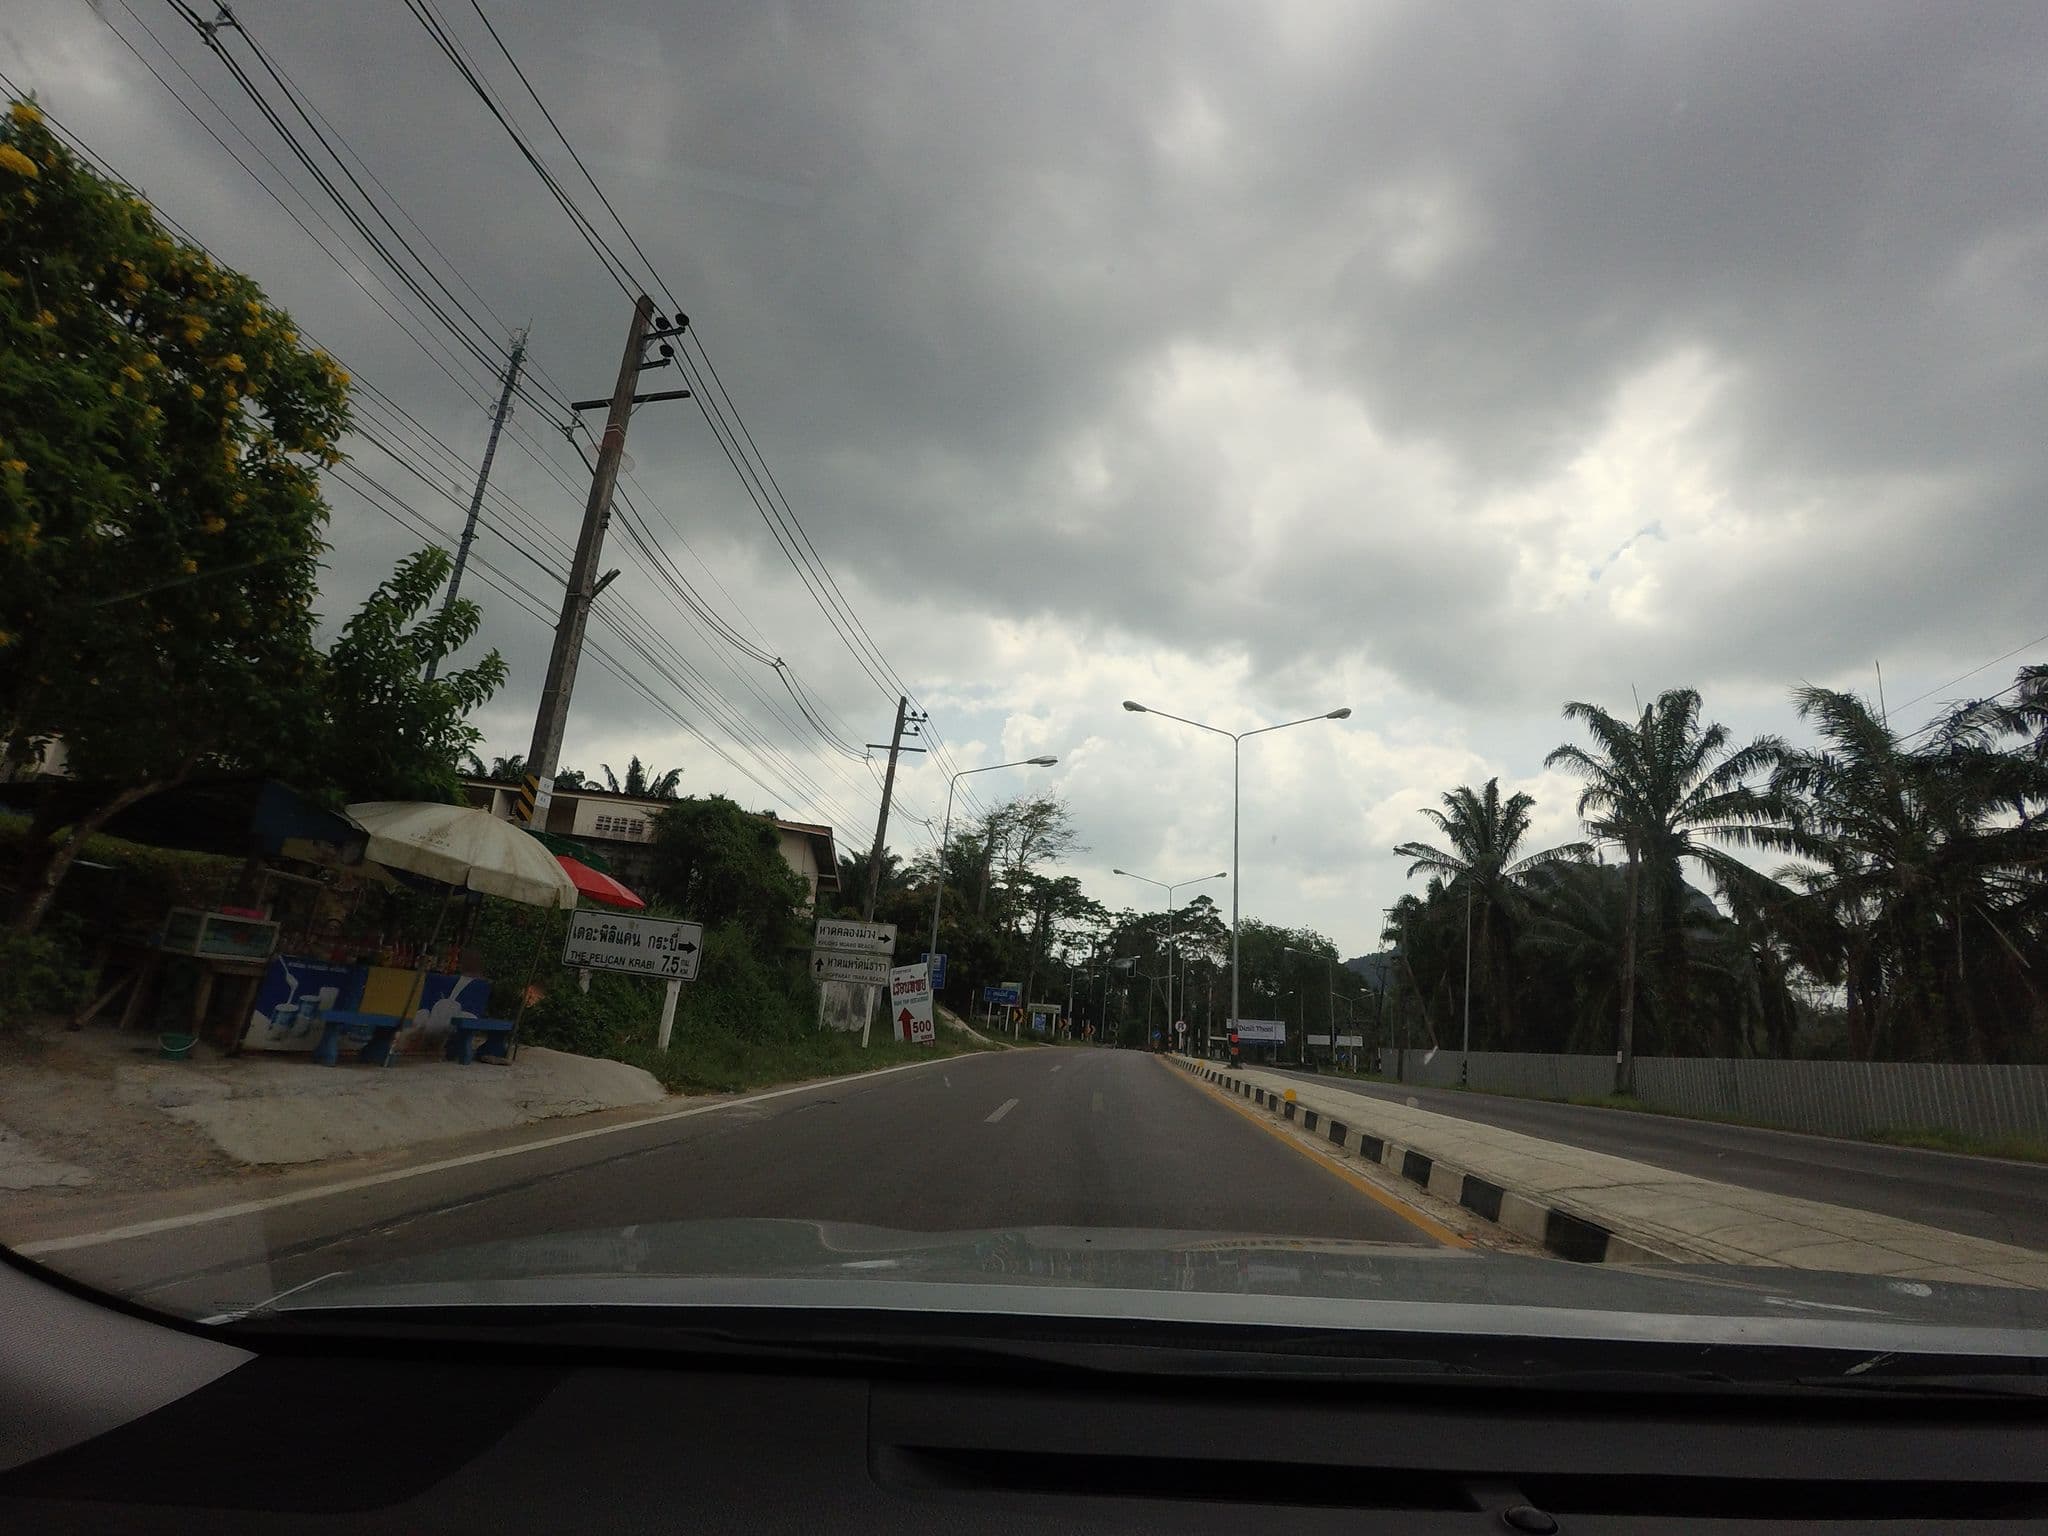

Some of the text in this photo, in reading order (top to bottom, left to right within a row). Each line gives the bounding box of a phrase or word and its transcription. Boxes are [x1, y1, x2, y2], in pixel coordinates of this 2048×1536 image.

[647, 927, 680, 951] กระบี่
[819, 925, 876, 940] หาดคลองม่วง
[570, 950, 655, 970] THE PELICAN KRABI
[661, 955, 680, 973] 7.5
[912, 1019, 932, 1034] 500
